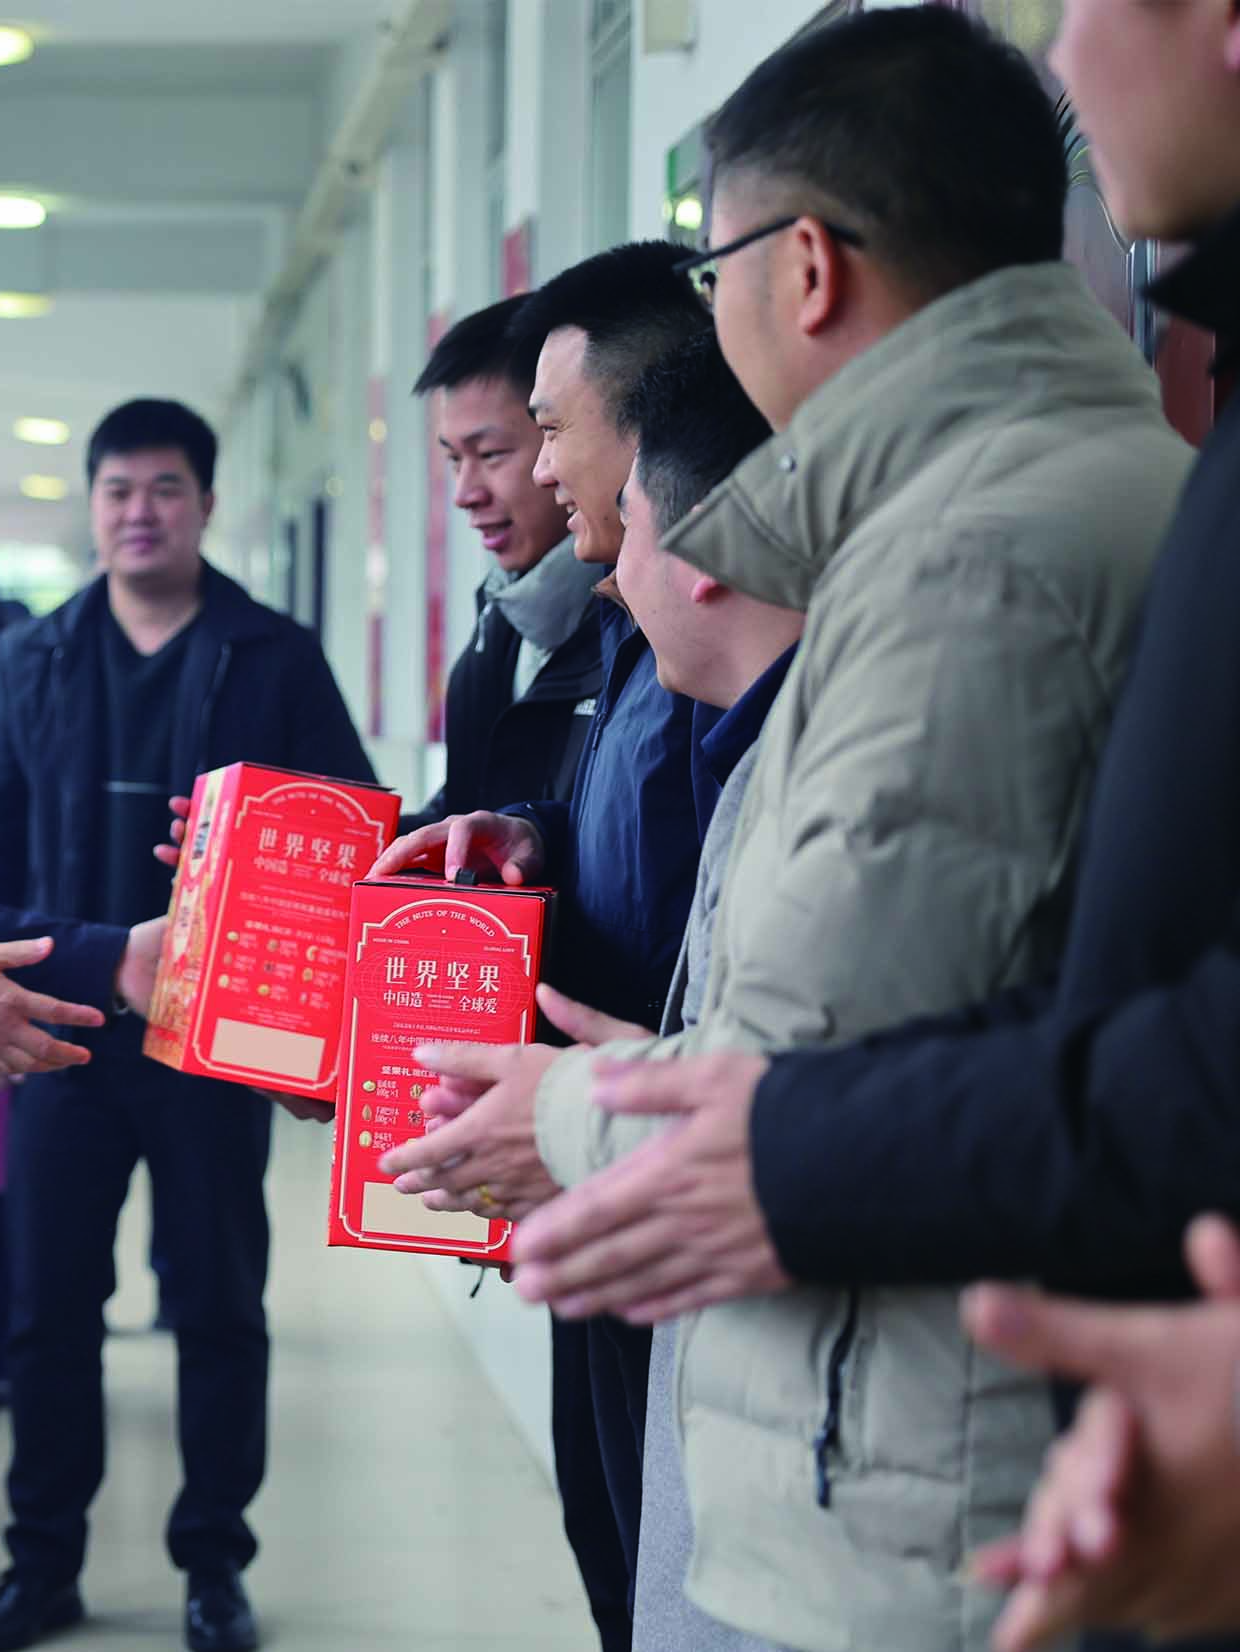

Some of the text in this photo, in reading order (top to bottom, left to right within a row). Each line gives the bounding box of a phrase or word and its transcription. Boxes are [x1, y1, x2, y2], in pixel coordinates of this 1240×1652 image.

[259, 827, 357, 869] 世界坚果
[395, 917, 411, 929] THE
[436, 909, 448, 918] OF
[450, 911, 466, 921] THE
[469, 915, 496, 938] WORLD
[384, 956, 502, 993] 世界坚果
[383, 990, 423, 1008] 中国造
[458, 995, 498, 1014] 全球爱
